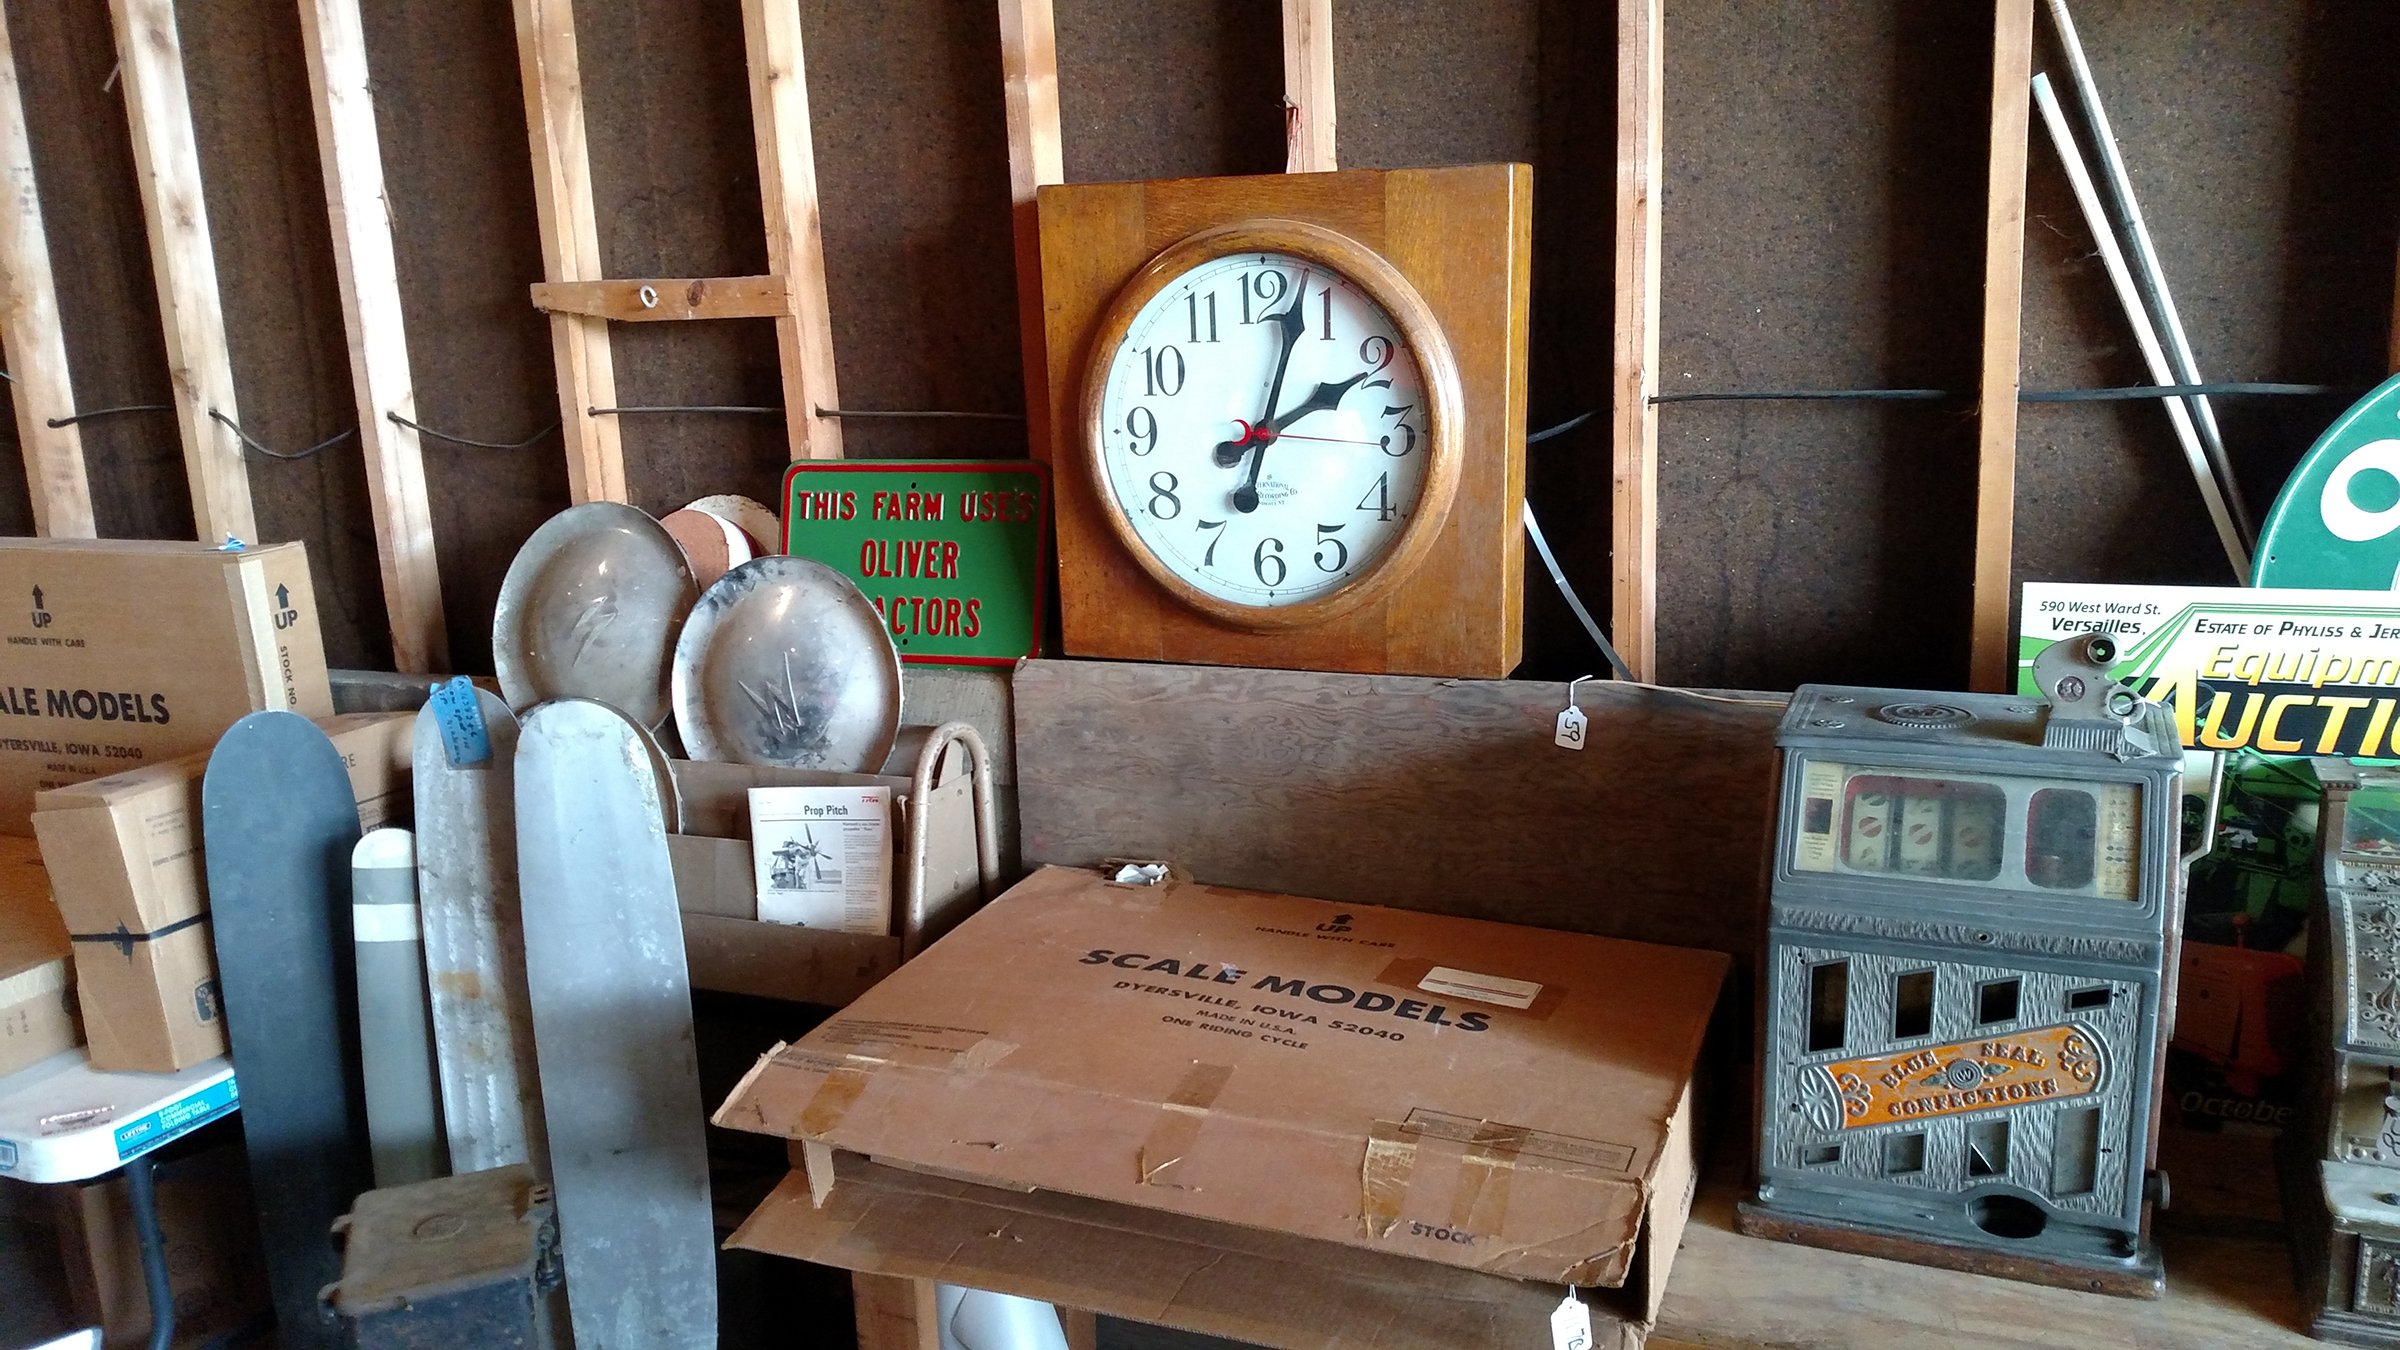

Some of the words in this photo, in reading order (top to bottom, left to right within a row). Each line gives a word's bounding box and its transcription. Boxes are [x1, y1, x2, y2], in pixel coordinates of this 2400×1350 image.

[1184, 290, 1221, 343] 11
[1237, 270, 1288, 324] 12
[1318, 287, 1336, 341] 1
[1141, 345, 1186, 397] 10
[1359, 336, 1394, 390] 2
[1126, 406, 1158, 456] 9
[1380, 404, 1416, 457] 3
[799, 490, 857, 520] THIS
[873, 491, 945, 521] FARM
[960, 490, 1034, 523] USES
[1148, 471, 1182, 520] 8
[1356, 471, 1397, 522] 4
[861, 539, 960, 579] OLIVER
[1196, 520, 1227, 567] 7
[1254, 538, 1287, 587] 6
[1314, 523, 1348, 572] 5
[32, 612, 52, 628] UP
[275, 609, 298, 630] UP
[876, 596, 981, 638] CTORS
[2040, 601, 2065, 612] 590
[2069, 602, 2101, 614] West
[2104, 603, 2140, 614] Ward
[2144, 604, 2161, 615] St.
[2052, 617, 2146, 635] Versailles,
[41, 638, 61, 647] WITH
[2350, 626, 2362, 638] &
[280, 645, 293, 683] STOCK
[2202, 643, 2400, 689] Equipm
[46, 689, 170, 725] MODELS
[0, 738, 62, 755] YERSVILLE,
[65, 743, 100, 757] IOWA
[104, 746, 143, 760] 52040
[804, 805, 824, 818] Prop
[826, 805, 849, 815] Pitch
[1256, 926, 1309, 938] HANDLE
[1317, 935, 1353, 943] WITH
[1360, 940, 1396, 948] CARE
[1316, 923, 1352, 933] UP
[1078, 949, 1247, 985] SCALE
[1251, 975, 1493, 1033] MODELS
[1113, 981, 1243, 1010] DYERSVILLE,
[1251, 1004, 1319, 1025] IOWA
[1328, 1019, 1406, 1043] 52040
[1196, 1010, 1236, 1023] MADE
[1240, 1018, 1255, 1026] IN
[1259, 1022, 1297, 1035] U.S.A.
[1162, 1015, 1194, 1027] ONE
[1199, 1023, 1253, 1038] RIDING
[1260, 1034, 1309, 1050] CYCLE
[1880, 1050, 1940, 1089] BLUE
[1981, 1042, 2047, 1068] SEAL
[1888, 1078, 2059, 1117] CONFECTIONS
[1410, 1222, 1477, 1247] STOCK
